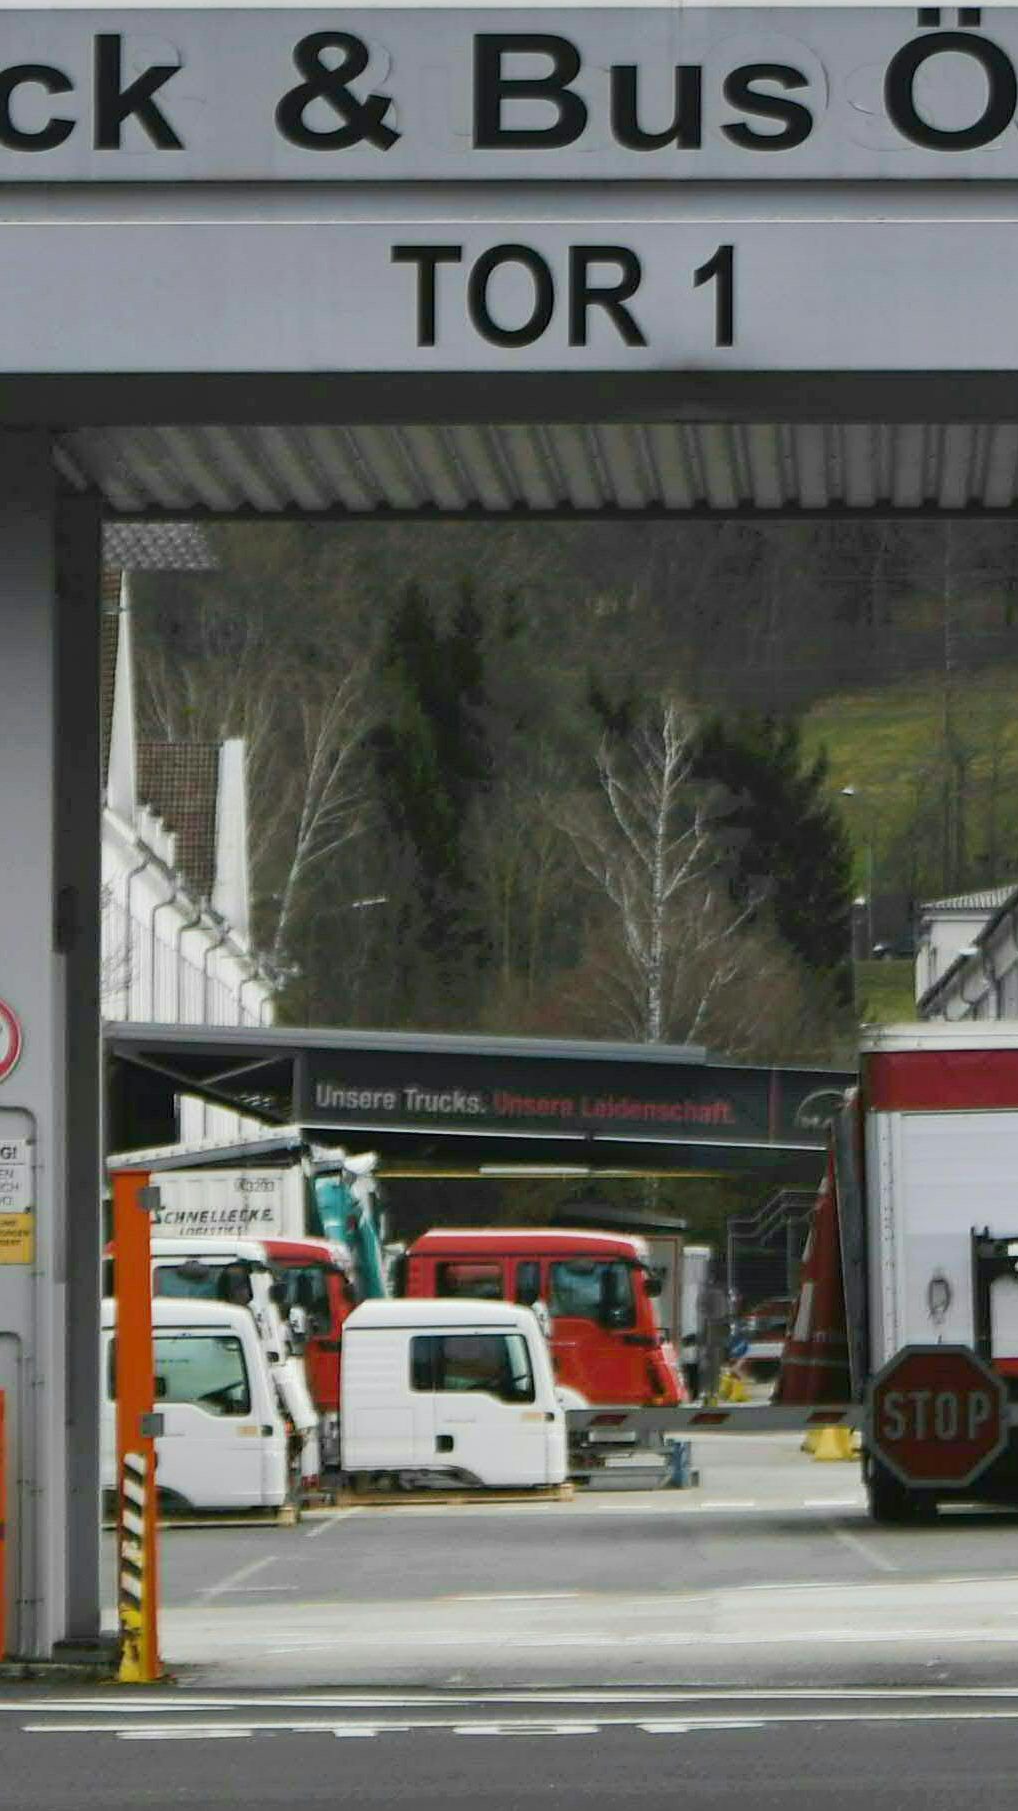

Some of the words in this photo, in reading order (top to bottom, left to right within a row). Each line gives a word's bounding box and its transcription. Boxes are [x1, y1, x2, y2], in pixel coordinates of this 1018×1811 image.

[0, 32, 186, 152] ck
[274, 30, 402, 152] &
[471, 32, 815, 152] Bus
[389, 243, 648, 349] TOR
[691, 244, 736, 348] 1
[316, 1084, 397, 1109] Unsere
[402, 1088, 487, 1114] Trucks.
[882, 1391, 992, 1440] STOP
